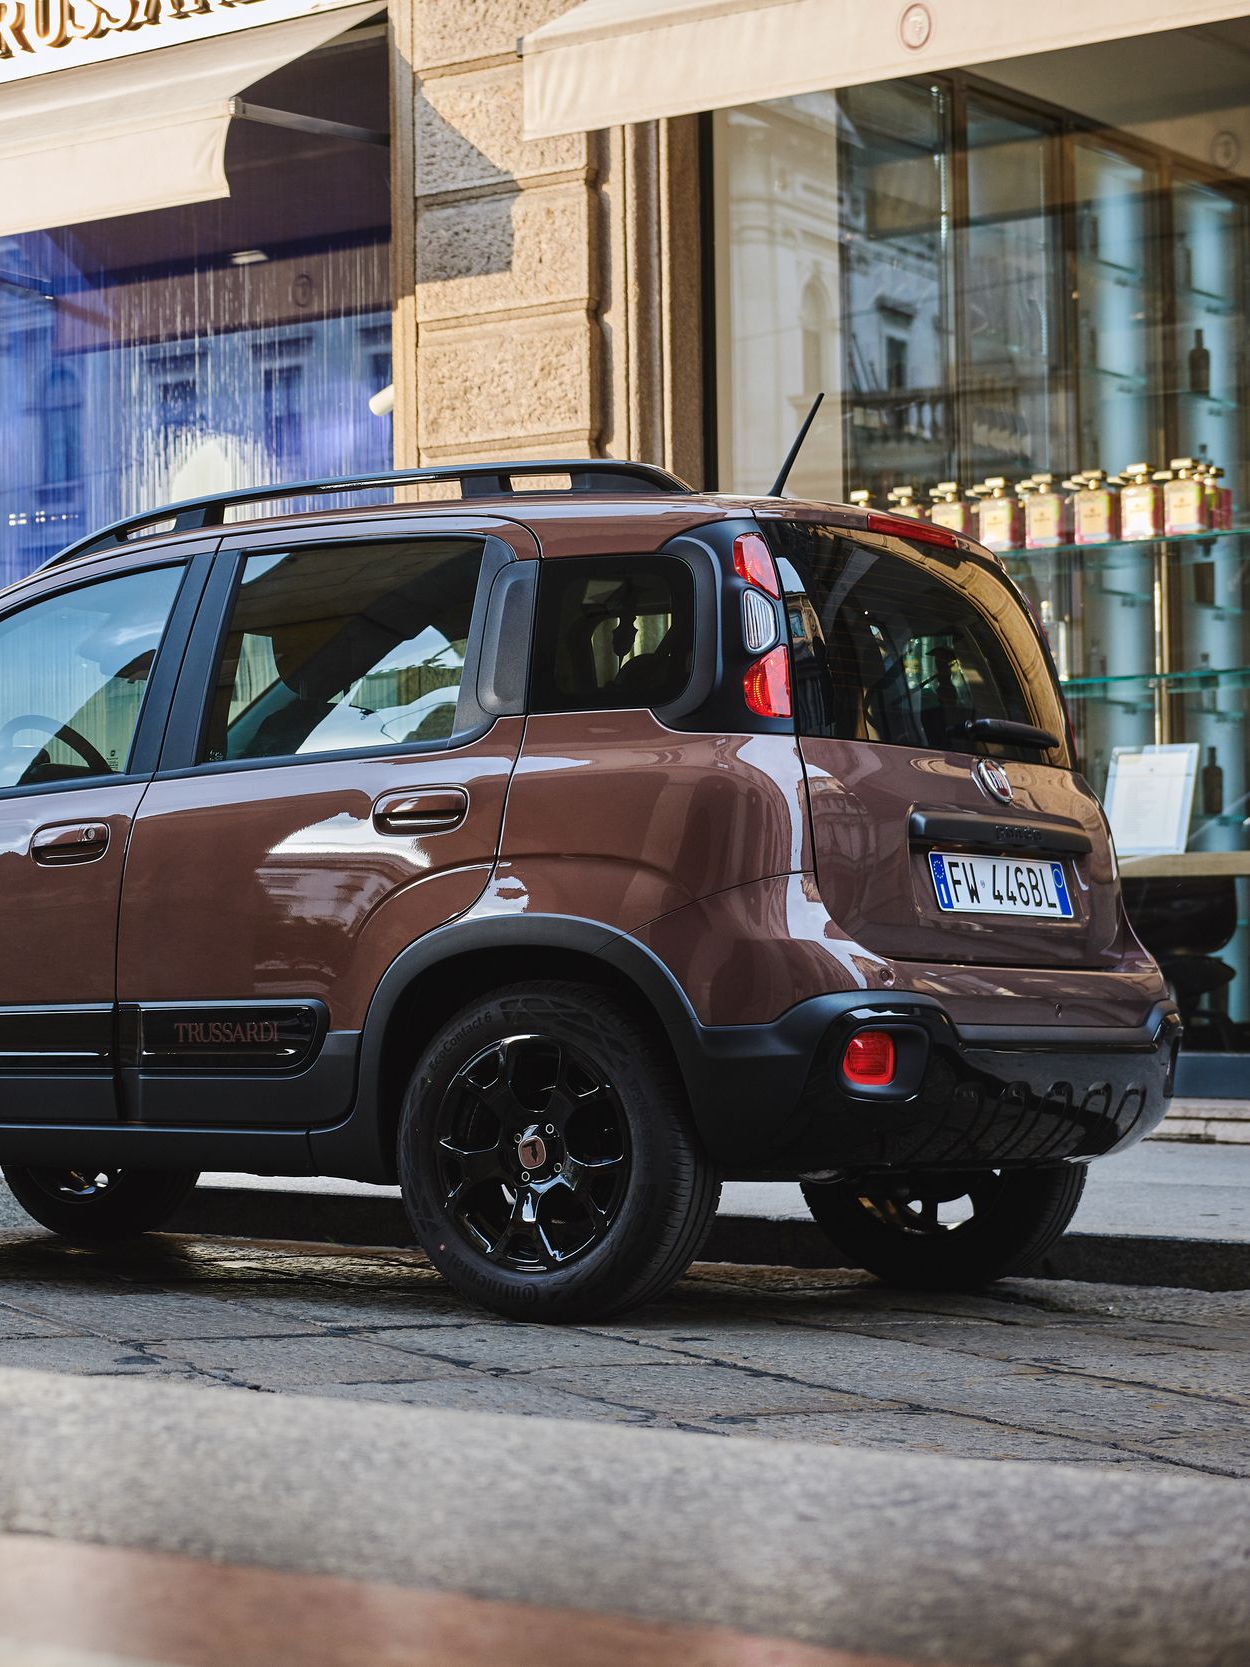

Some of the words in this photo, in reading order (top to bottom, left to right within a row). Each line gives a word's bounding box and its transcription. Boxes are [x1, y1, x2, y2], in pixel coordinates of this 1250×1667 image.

[948, 861, 980, 904] FW
[992, 864, 1057, 908] 446BL
[174, 1021, 279, 1043] TRUSSARDI
